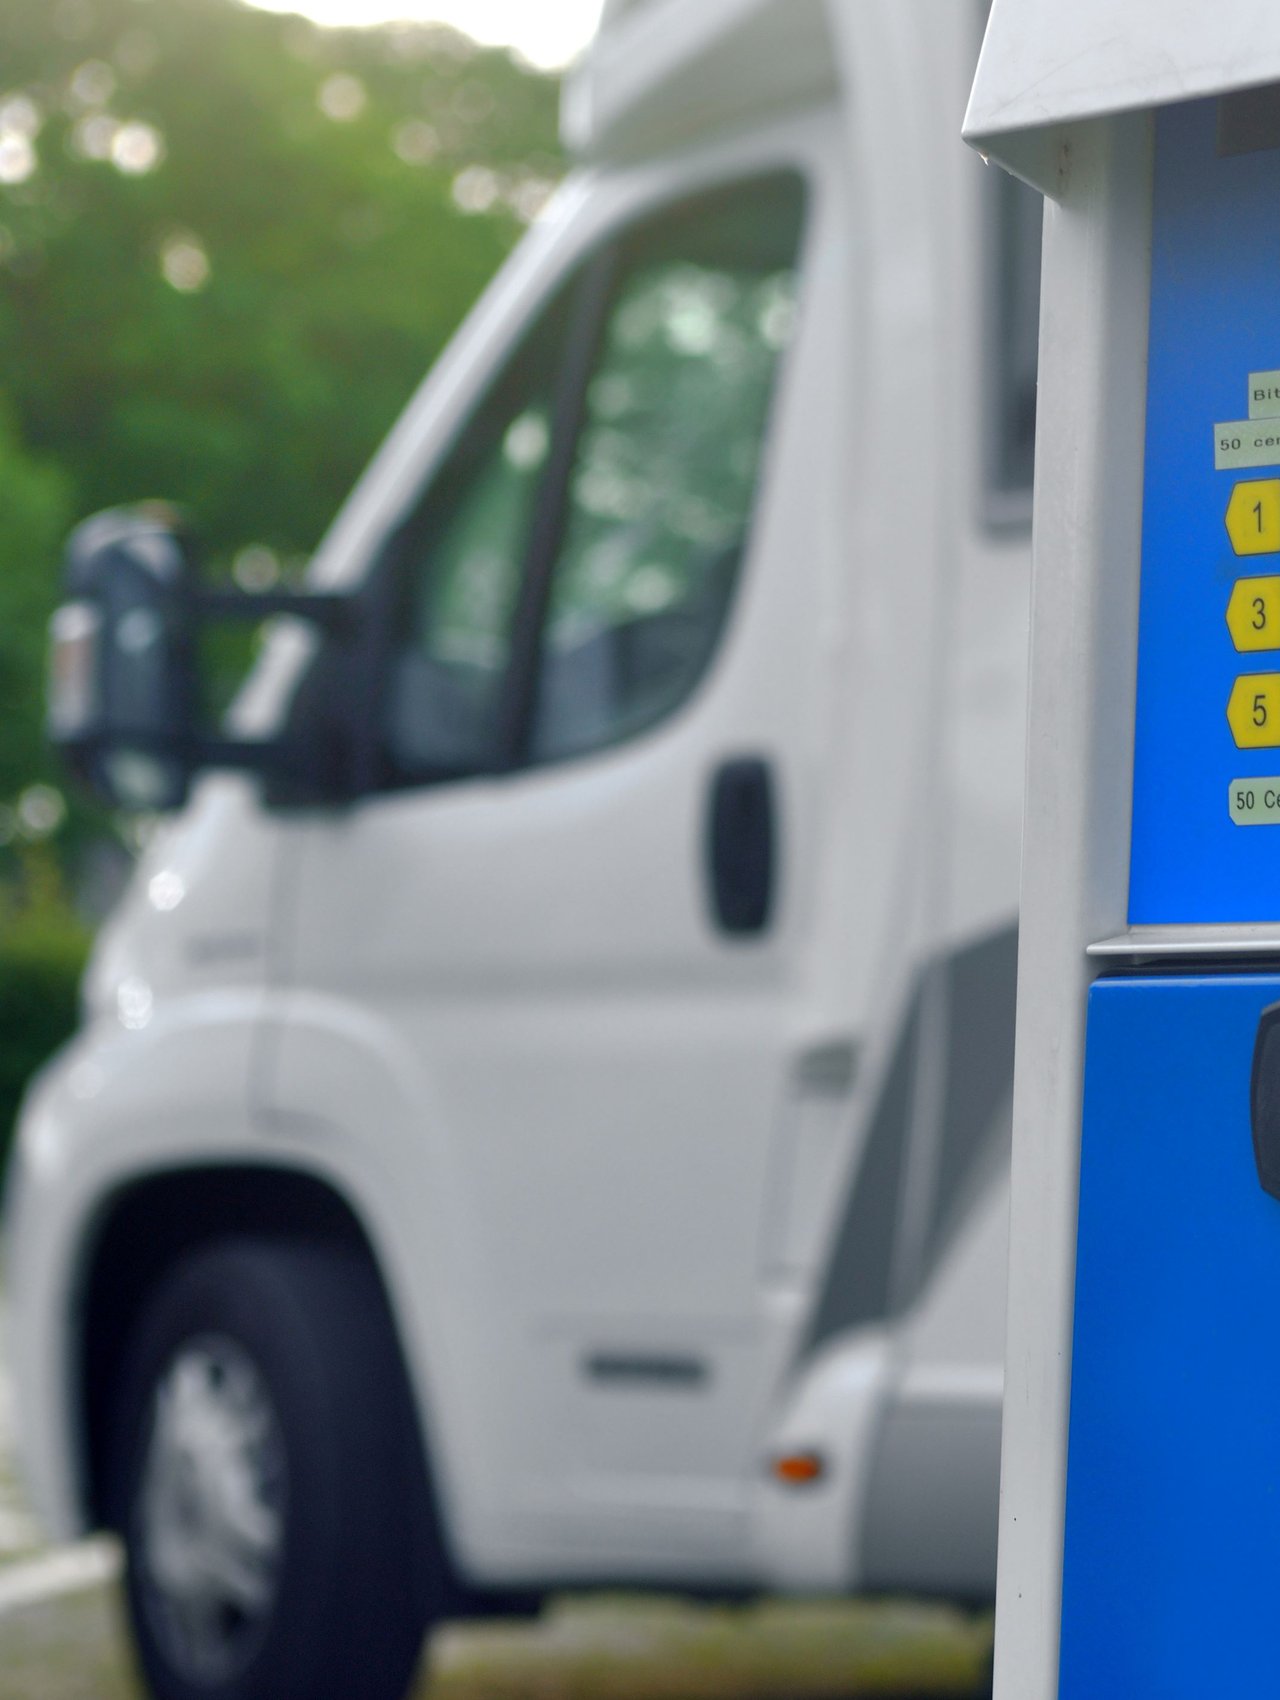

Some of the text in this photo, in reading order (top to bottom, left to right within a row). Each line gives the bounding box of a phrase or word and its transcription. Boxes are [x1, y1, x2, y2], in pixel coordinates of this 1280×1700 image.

[1219, 438, 1242, 451] 50
[1252, 500, 1263, 533] 1
[1251, 597, 1267, 631] 3
[1252, 694, 1267, 727] 5
[1236, 790, 1255, 810] 50
